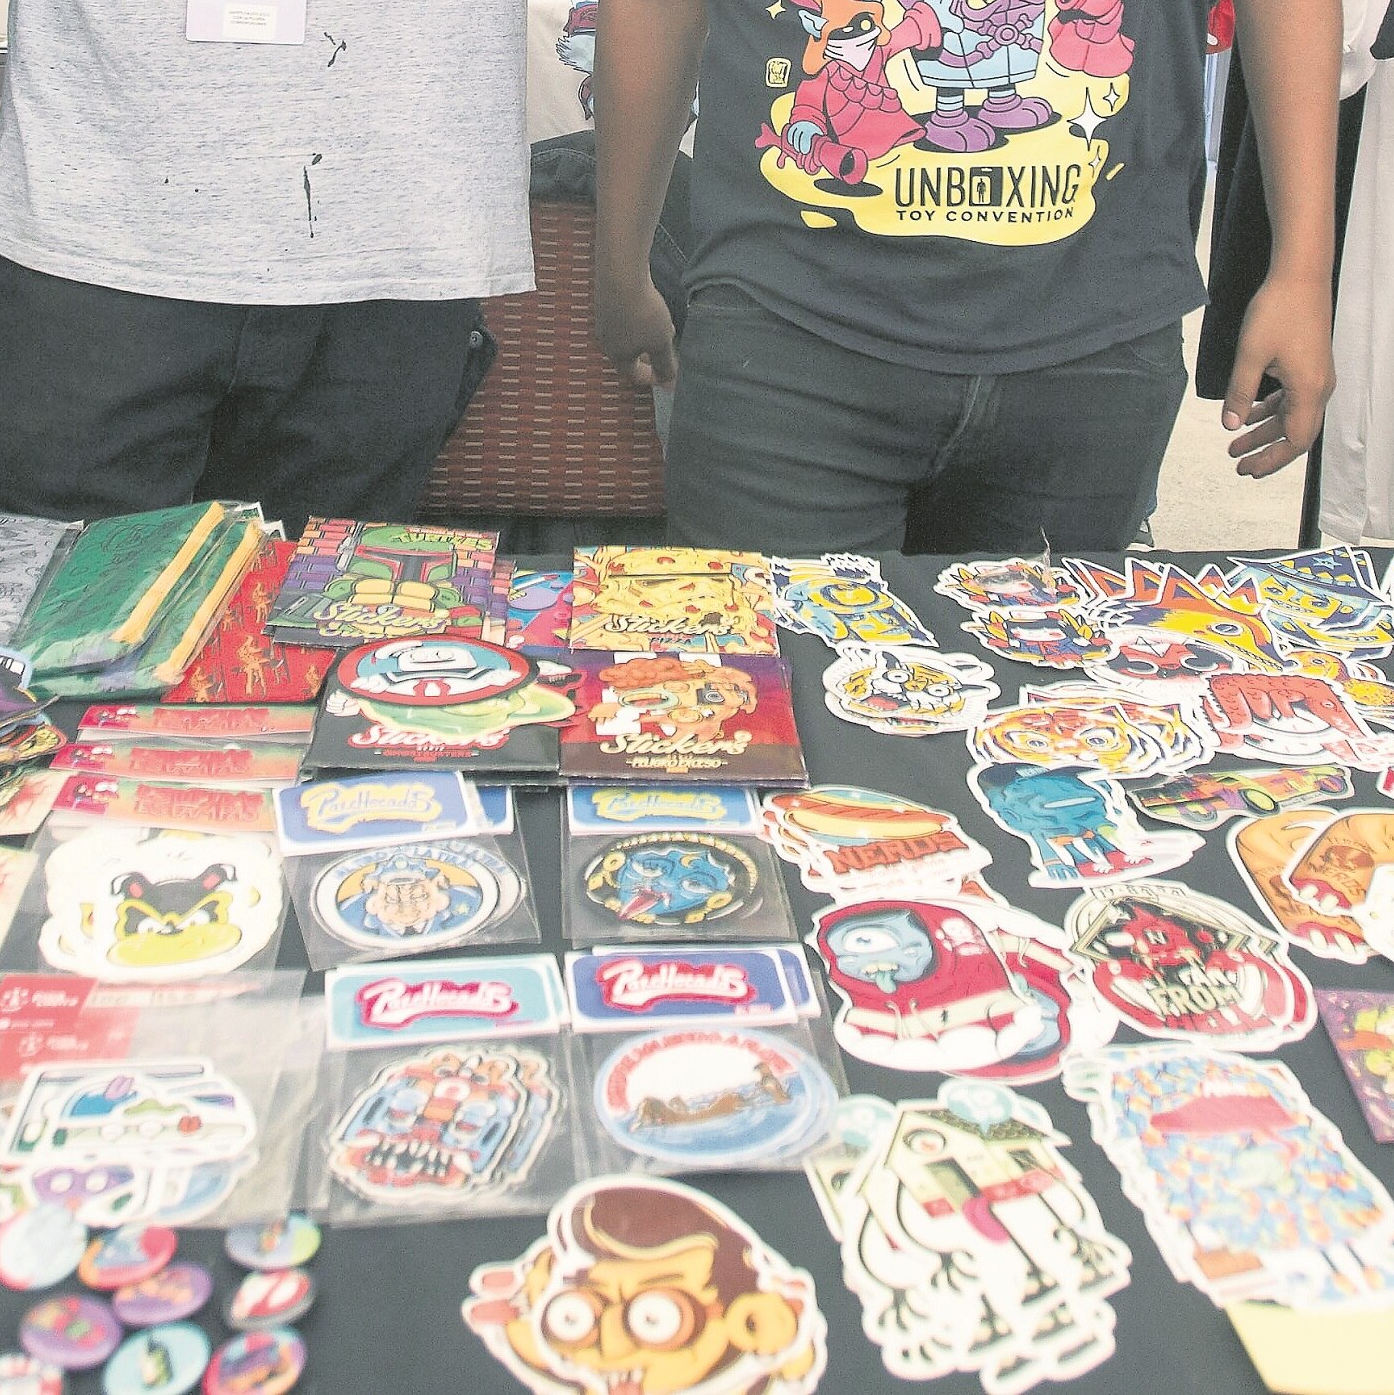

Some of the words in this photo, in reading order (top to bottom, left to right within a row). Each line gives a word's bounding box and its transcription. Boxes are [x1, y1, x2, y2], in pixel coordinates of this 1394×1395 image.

[895, 210, 939, 224] TOY
[945, 206, 1075, 225] CONVENTION
[314, 600, 452, 631] Stickers
[605, 612, 735, 636] Stickers
[599, 728, 752, 756] Stickers
[821, 832, 970, 873] NERDS
[1146, 985, 1242, 1015] FROM
